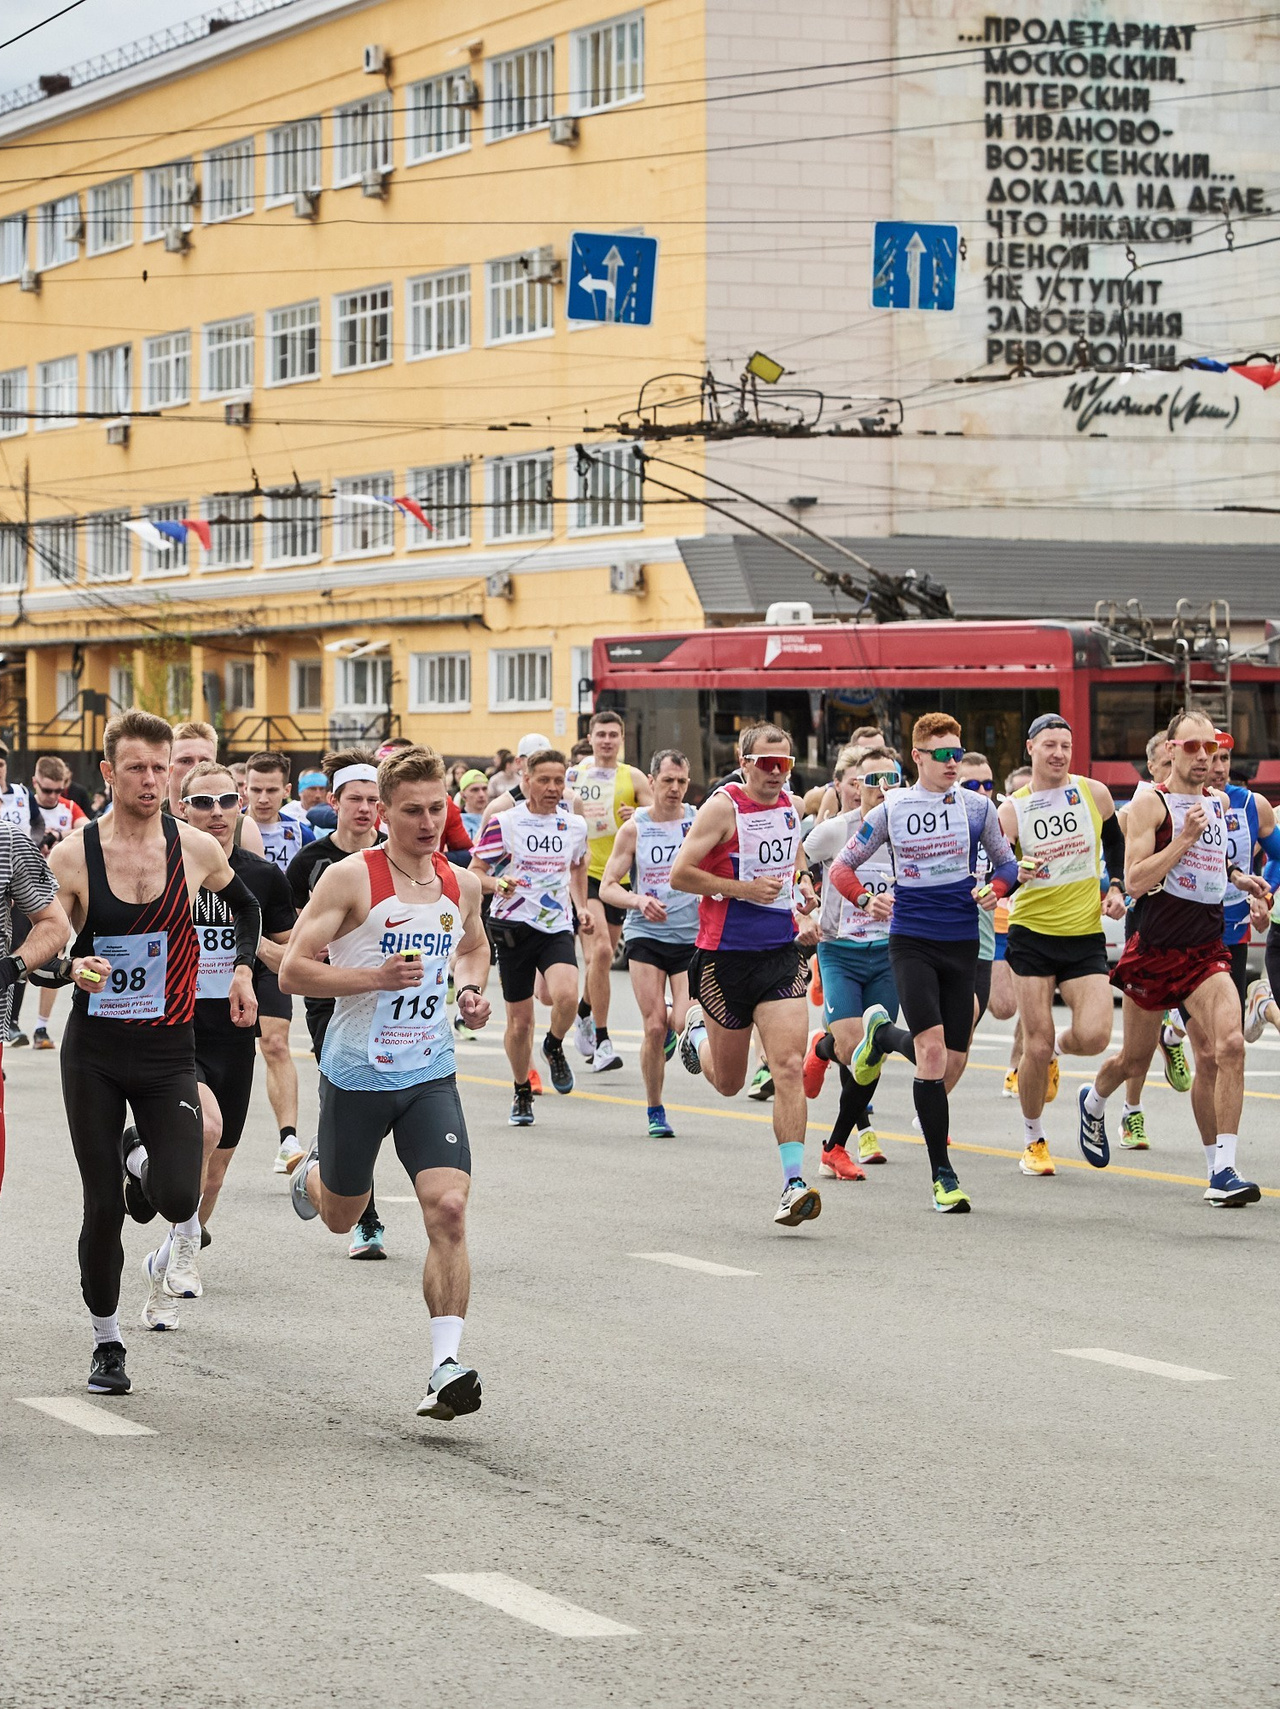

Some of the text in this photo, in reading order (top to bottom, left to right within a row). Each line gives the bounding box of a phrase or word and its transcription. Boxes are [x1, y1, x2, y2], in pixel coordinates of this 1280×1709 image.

[984, 81, 1151, 113] ПИТЕРСКИЙ
[985, 113, 1173, 145] И ИВАНОВО-
[986, 177, 1124, 208] ДОКАЗАЛ
[1136, 182, 1176, 210] НА
[986, 209, 1193, 244] ЧТО НИКАКОЙ
[986, 241, 1090, 270] ЦЕНОЙ
[986, 274, 1163, 306] НЕ УСТУПИТ
[987, 306, 1183, 338] ЗАВОЕВАНИЯ
[907, 810, 950, 836] 091
[1034, 812, 1078, 840] 036
[526, 834, 563, 853] 040
[651, 843, 682, 864] 07
[759, 836, 793, 864] 037
[379, 932, 452, 957] RUSSIA
[111, 967, 147, 994] 98
[99, 1001, 131, 1010] КРАСНЫЙ
[391, 995, 439, 1020] 118
[380, 1030, 412, 1038] КРАСНЫЙ
